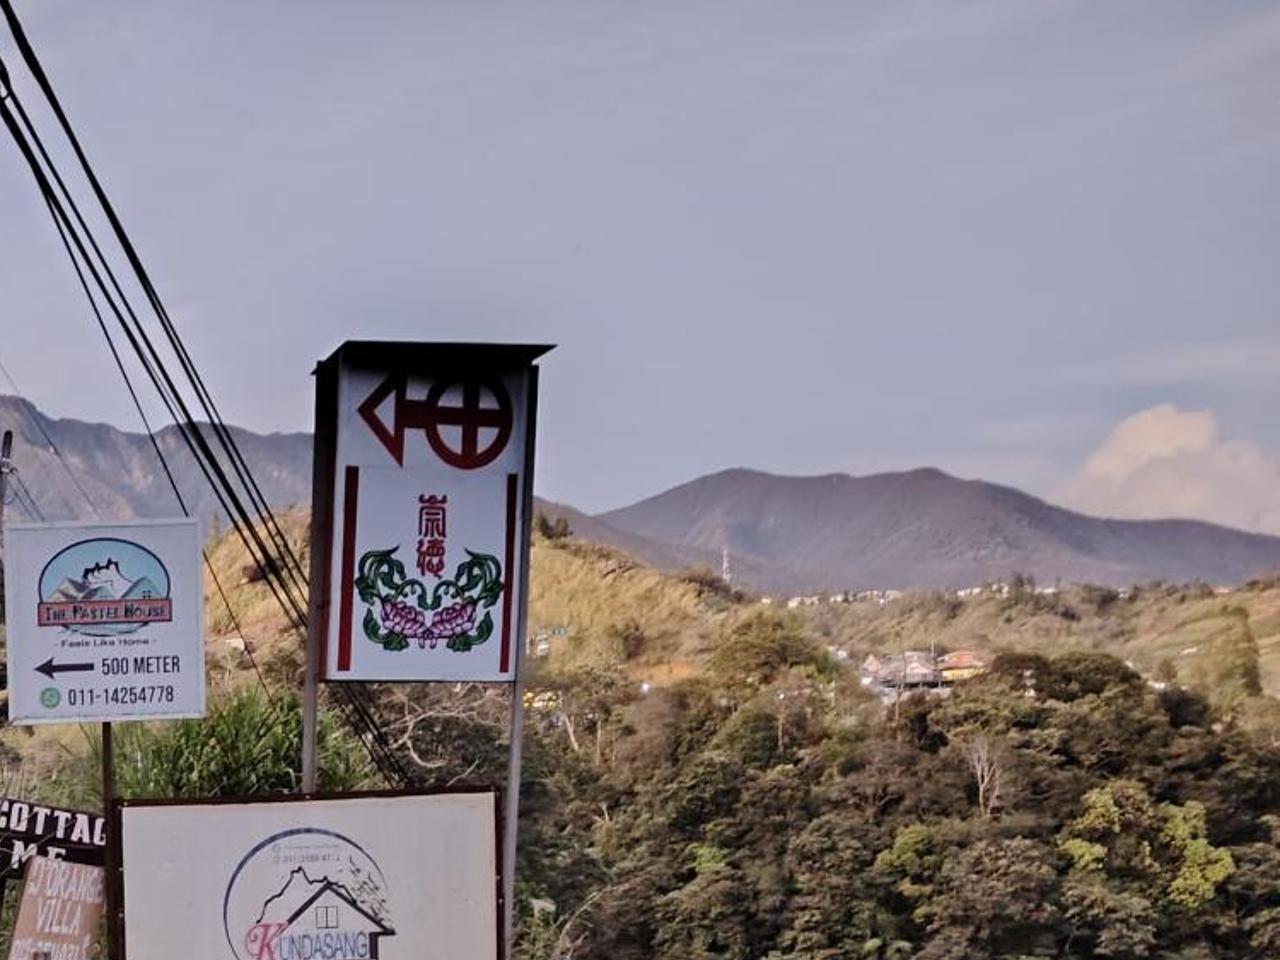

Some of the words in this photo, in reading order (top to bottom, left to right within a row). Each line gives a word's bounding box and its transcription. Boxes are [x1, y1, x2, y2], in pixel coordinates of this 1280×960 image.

[123, 602, 166, 618] HOUSE
[102, 657, 129, 675] 500
[133, 655, 181, 673] METER
[67, 686, 175, 706] 011-14254778
